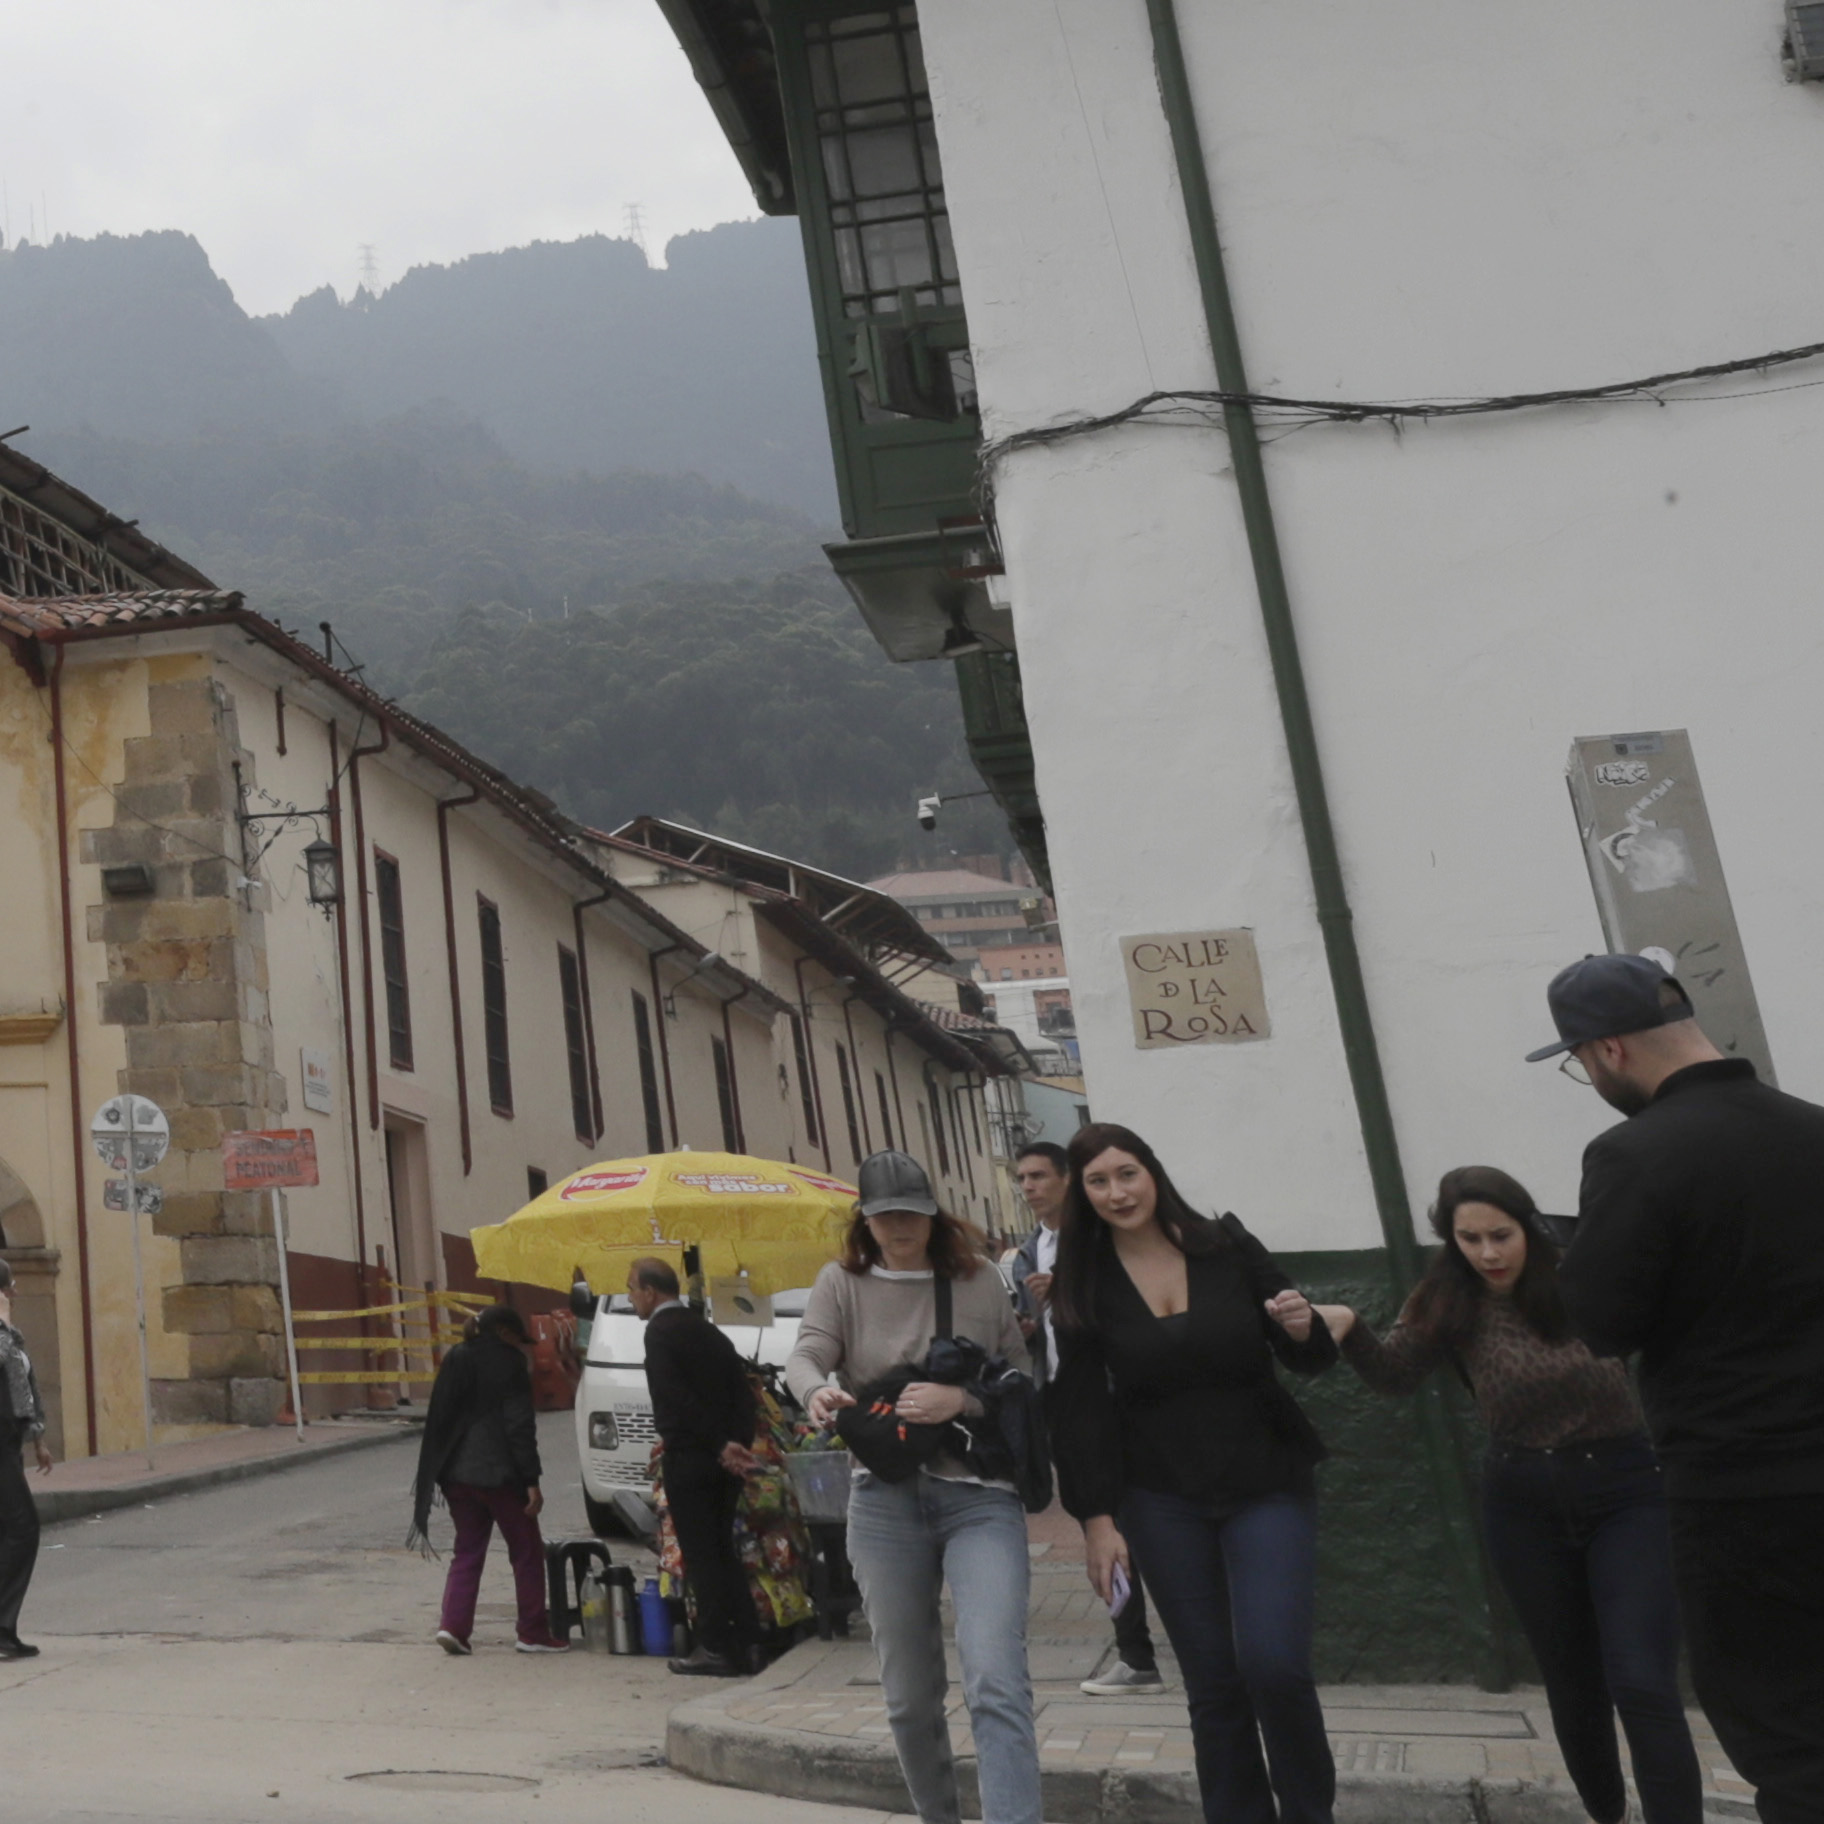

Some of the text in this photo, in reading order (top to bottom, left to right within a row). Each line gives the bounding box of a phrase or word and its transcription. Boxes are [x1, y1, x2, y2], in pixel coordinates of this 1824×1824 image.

[1132, 938, 1229, 973] CALLE
[1188, 978, 1227, 1005] LA
[1139, 1004, 1257, 1042] ROSA
[709, 1181, 789, 1193] sabor
